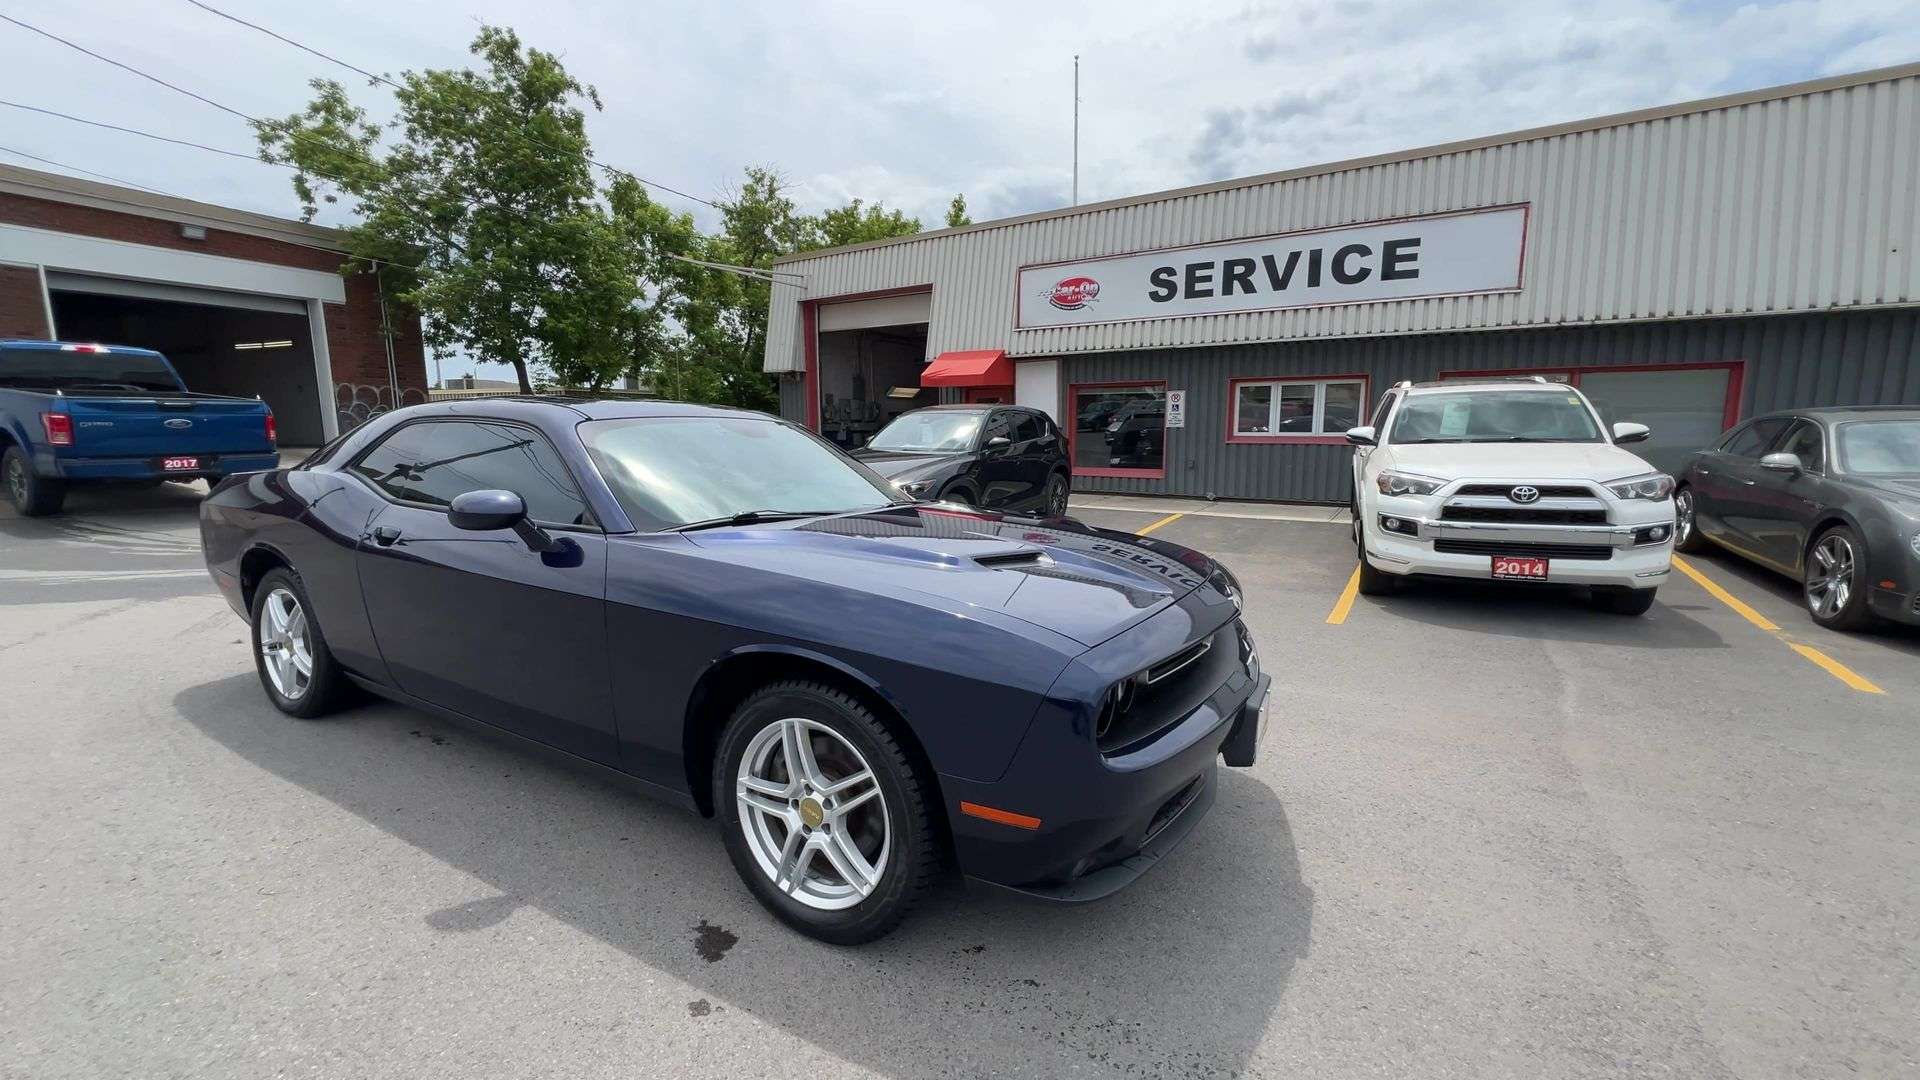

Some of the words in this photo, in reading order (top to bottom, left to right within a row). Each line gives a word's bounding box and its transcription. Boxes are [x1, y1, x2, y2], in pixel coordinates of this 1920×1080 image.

[1148, 237, 1422, 303] SERVICE
[164, 459, 197, 467] 2017
[1496, 562, 1544, 575] 2014
